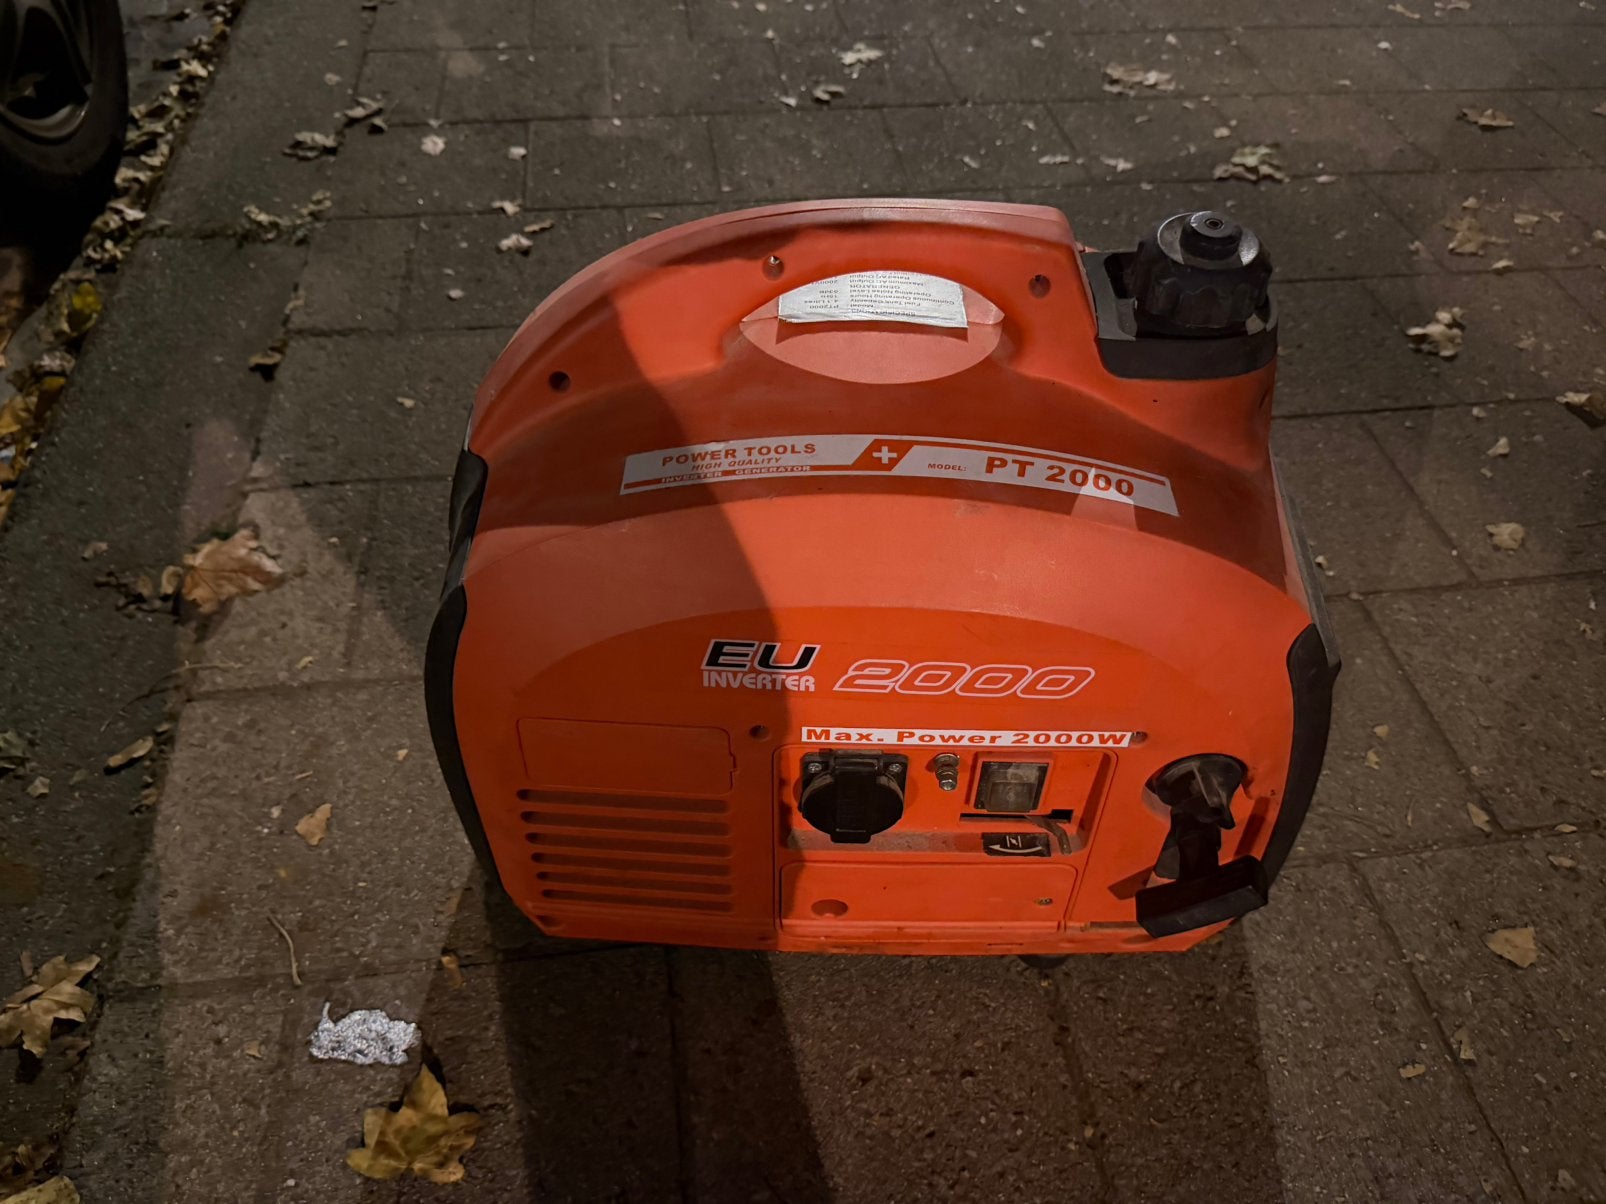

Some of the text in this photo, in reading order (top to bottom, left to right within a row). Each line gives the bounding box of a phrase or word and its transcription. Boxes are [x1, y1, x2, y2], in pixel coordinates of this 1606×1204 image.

[661, 443, 817, 467] POWER TOOLS
[690, 456, 783, 472] HIGH QUALITY
[661, 465, 812, 484] INVERTER GENERATOR
[927, 456, 1135, 497] MODEL: PT 2000
[700, 638, 1096, 700] EU 2000
[702, 672, 817, 692] INVERTER
[805, 728, 1130, 746] Max. Power 2000W
